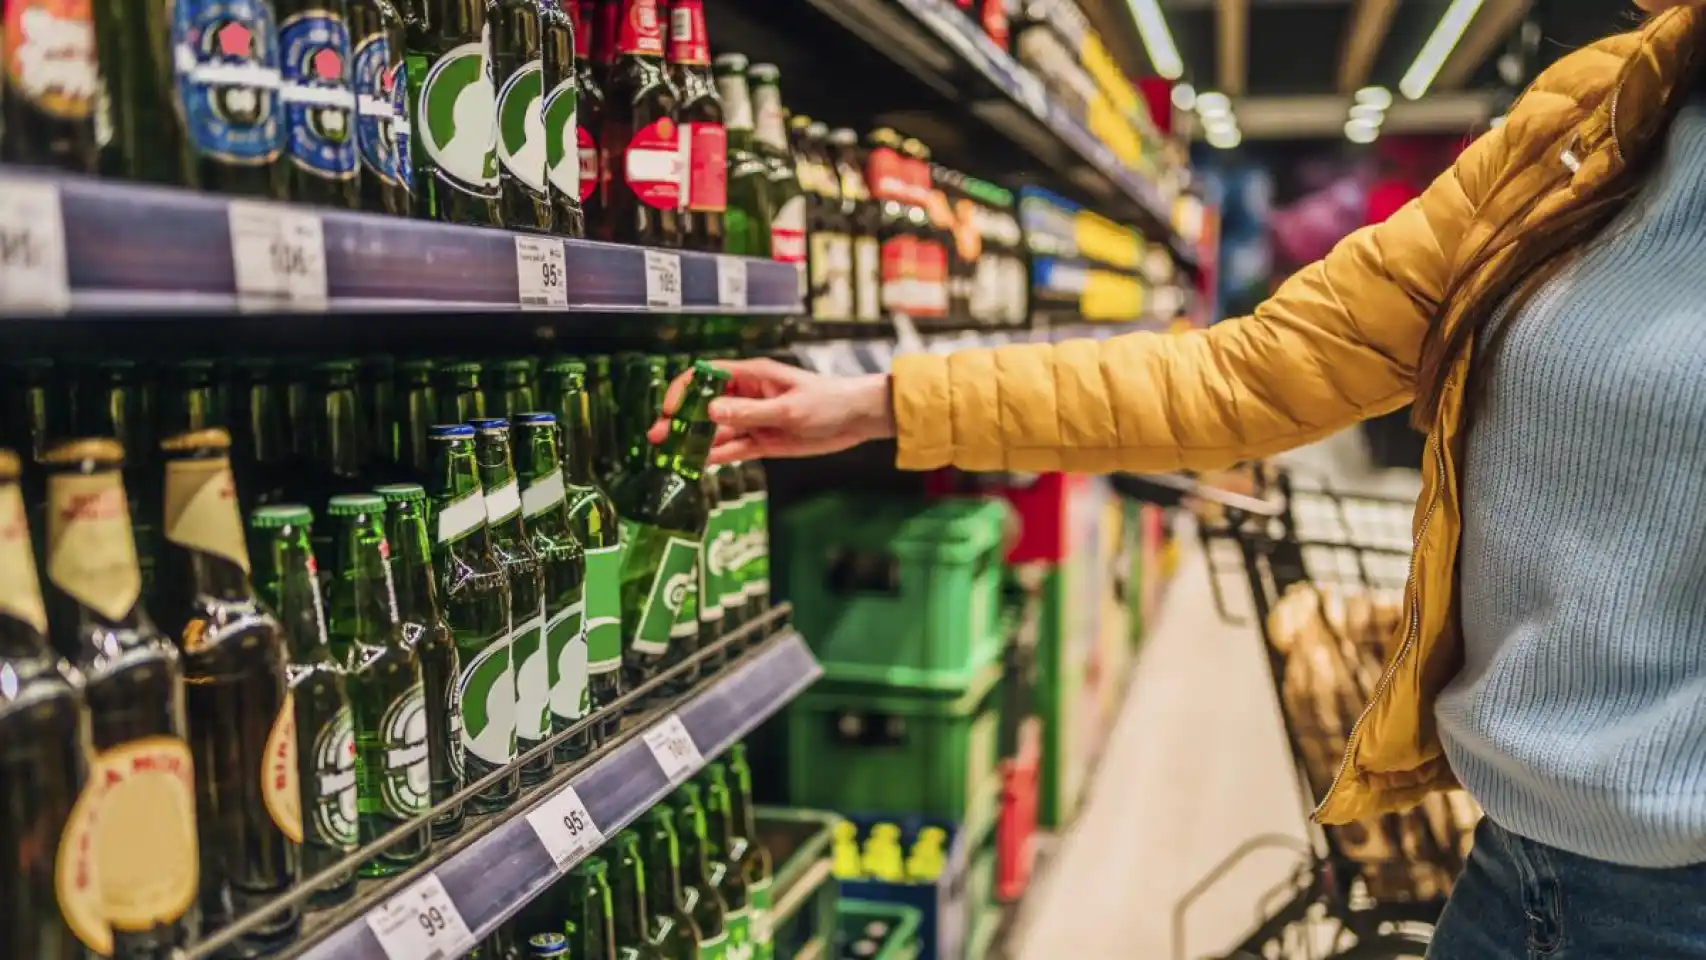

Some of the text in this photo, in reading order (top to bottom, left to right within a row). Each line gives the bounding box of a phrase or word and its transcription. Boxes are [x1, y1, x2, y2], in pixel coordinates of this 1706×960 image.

[542, 263, 557, 286] 95
[564, 810, 584, 836] 95
[419, 906, 445, 937] 99
